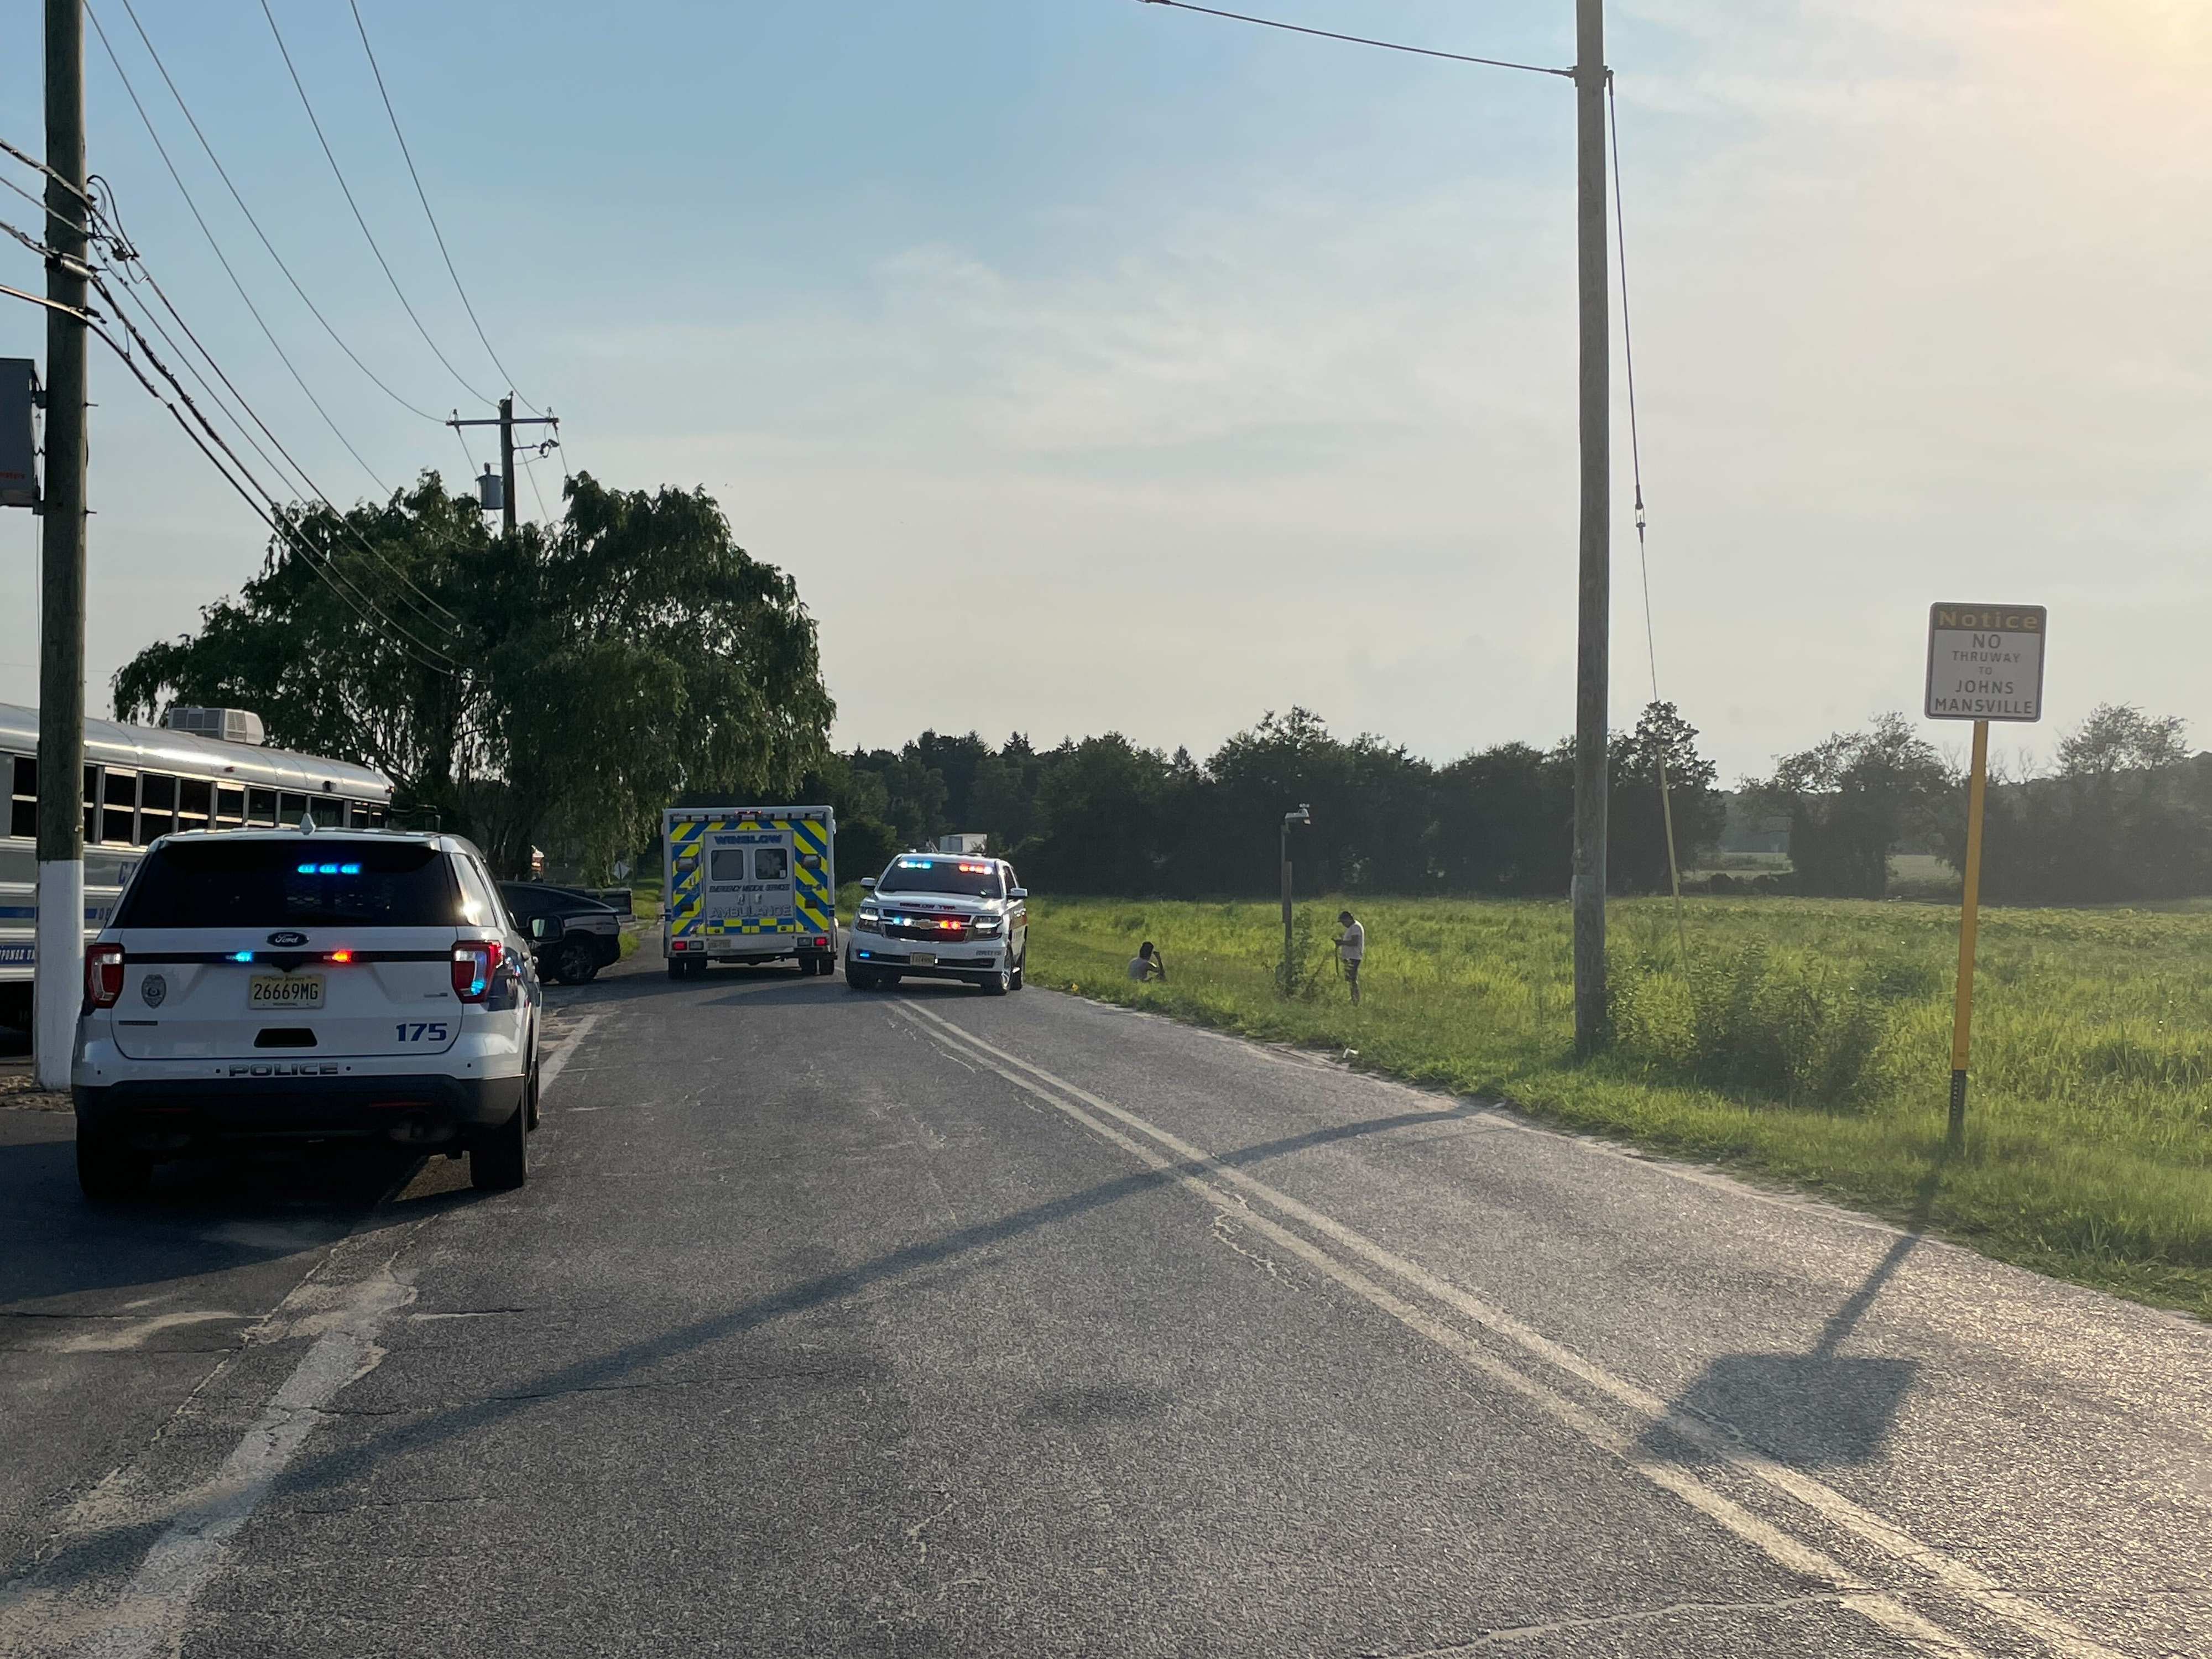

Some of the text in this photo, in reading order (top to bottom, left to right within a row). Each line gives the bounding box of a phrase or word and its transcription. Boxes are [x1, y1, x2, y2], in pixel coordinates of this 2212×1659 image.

[1939, 610, 2038, 629] Notice
[1972, 634, 2001, 649] NO
[1952, 650, 2021, 663] THRUWAY
[1979, 666, 1993, 675] TO
[1955, 680, 2015, 694] JOHNS
[1935, 697, 2033, 714] MANSVILLE
[714, 834, 782, 844] WINSLOW
[709, 904, 791, 918] AMBULANCE
[275, 933, 299, 943] Ford
[253, 983, 319, 1000] 26669MG
[396, 1023, 447, 1042] 175
[229, 1062, 338, 1077] POLICE
